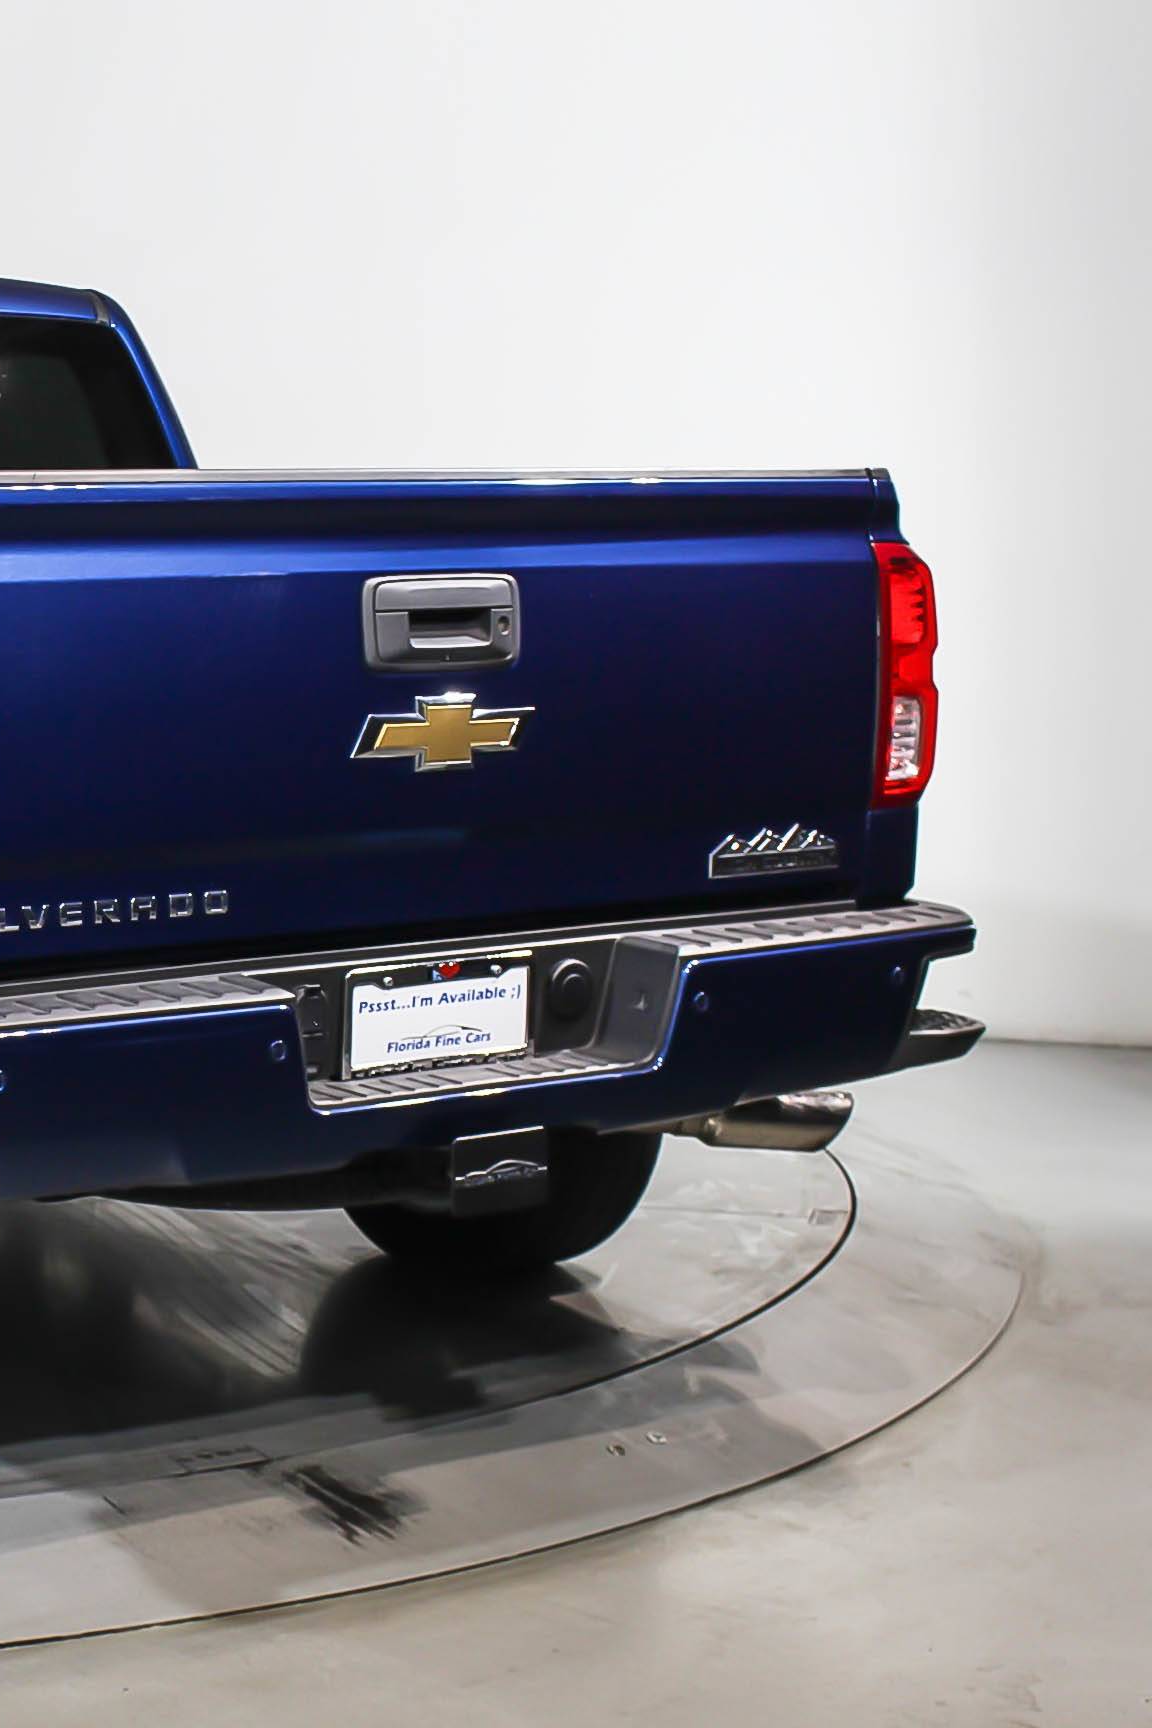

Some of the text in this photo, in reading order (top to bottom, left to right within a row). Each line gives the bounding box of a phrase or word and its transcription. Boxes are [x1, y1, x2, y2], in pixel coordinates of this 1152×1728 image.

[438, 986, 506, 1005] Available
[386, 1032, 491, 1053] Florida Fine Cars
